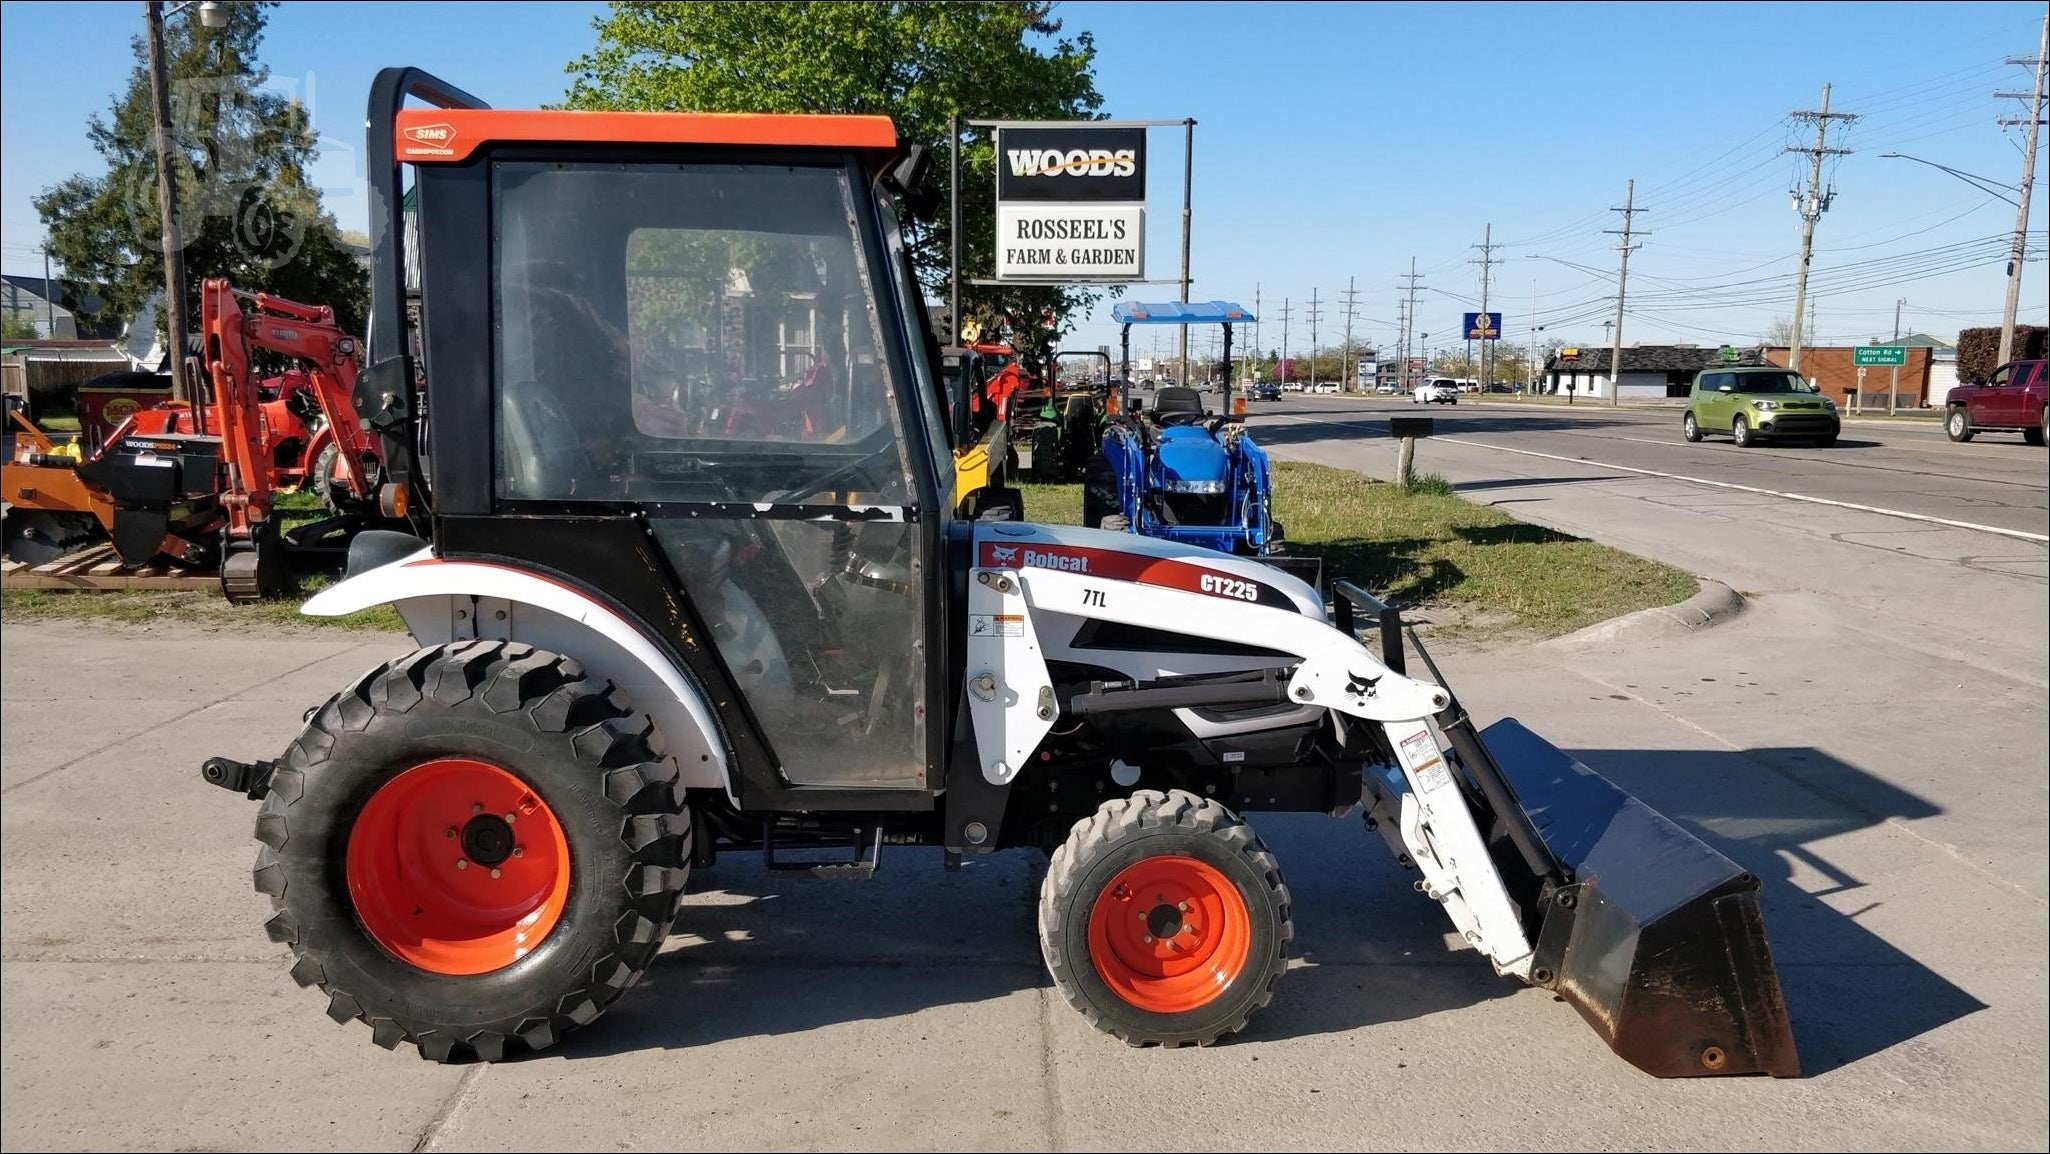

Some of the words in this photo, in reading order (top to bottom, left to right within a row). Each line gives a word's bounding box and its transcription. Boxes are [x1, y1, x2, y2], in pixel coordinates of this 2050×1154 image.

[416, 129, 447, 140] SIMS
[1007, 149, 1136, 177] WOODS
[1017, 219, 1126, 240] ROSSEEL'S
[1006, 249, 1051, 265] FARM
[1055, 249, 1068, 265] &
[1071, 249, 1136, 265] GARDEN
[1023, 550, 1089, 572] Bobcat
[1082, 588, 1107, 608] 7TL
[1200, 574, 1258, 601] CT225
